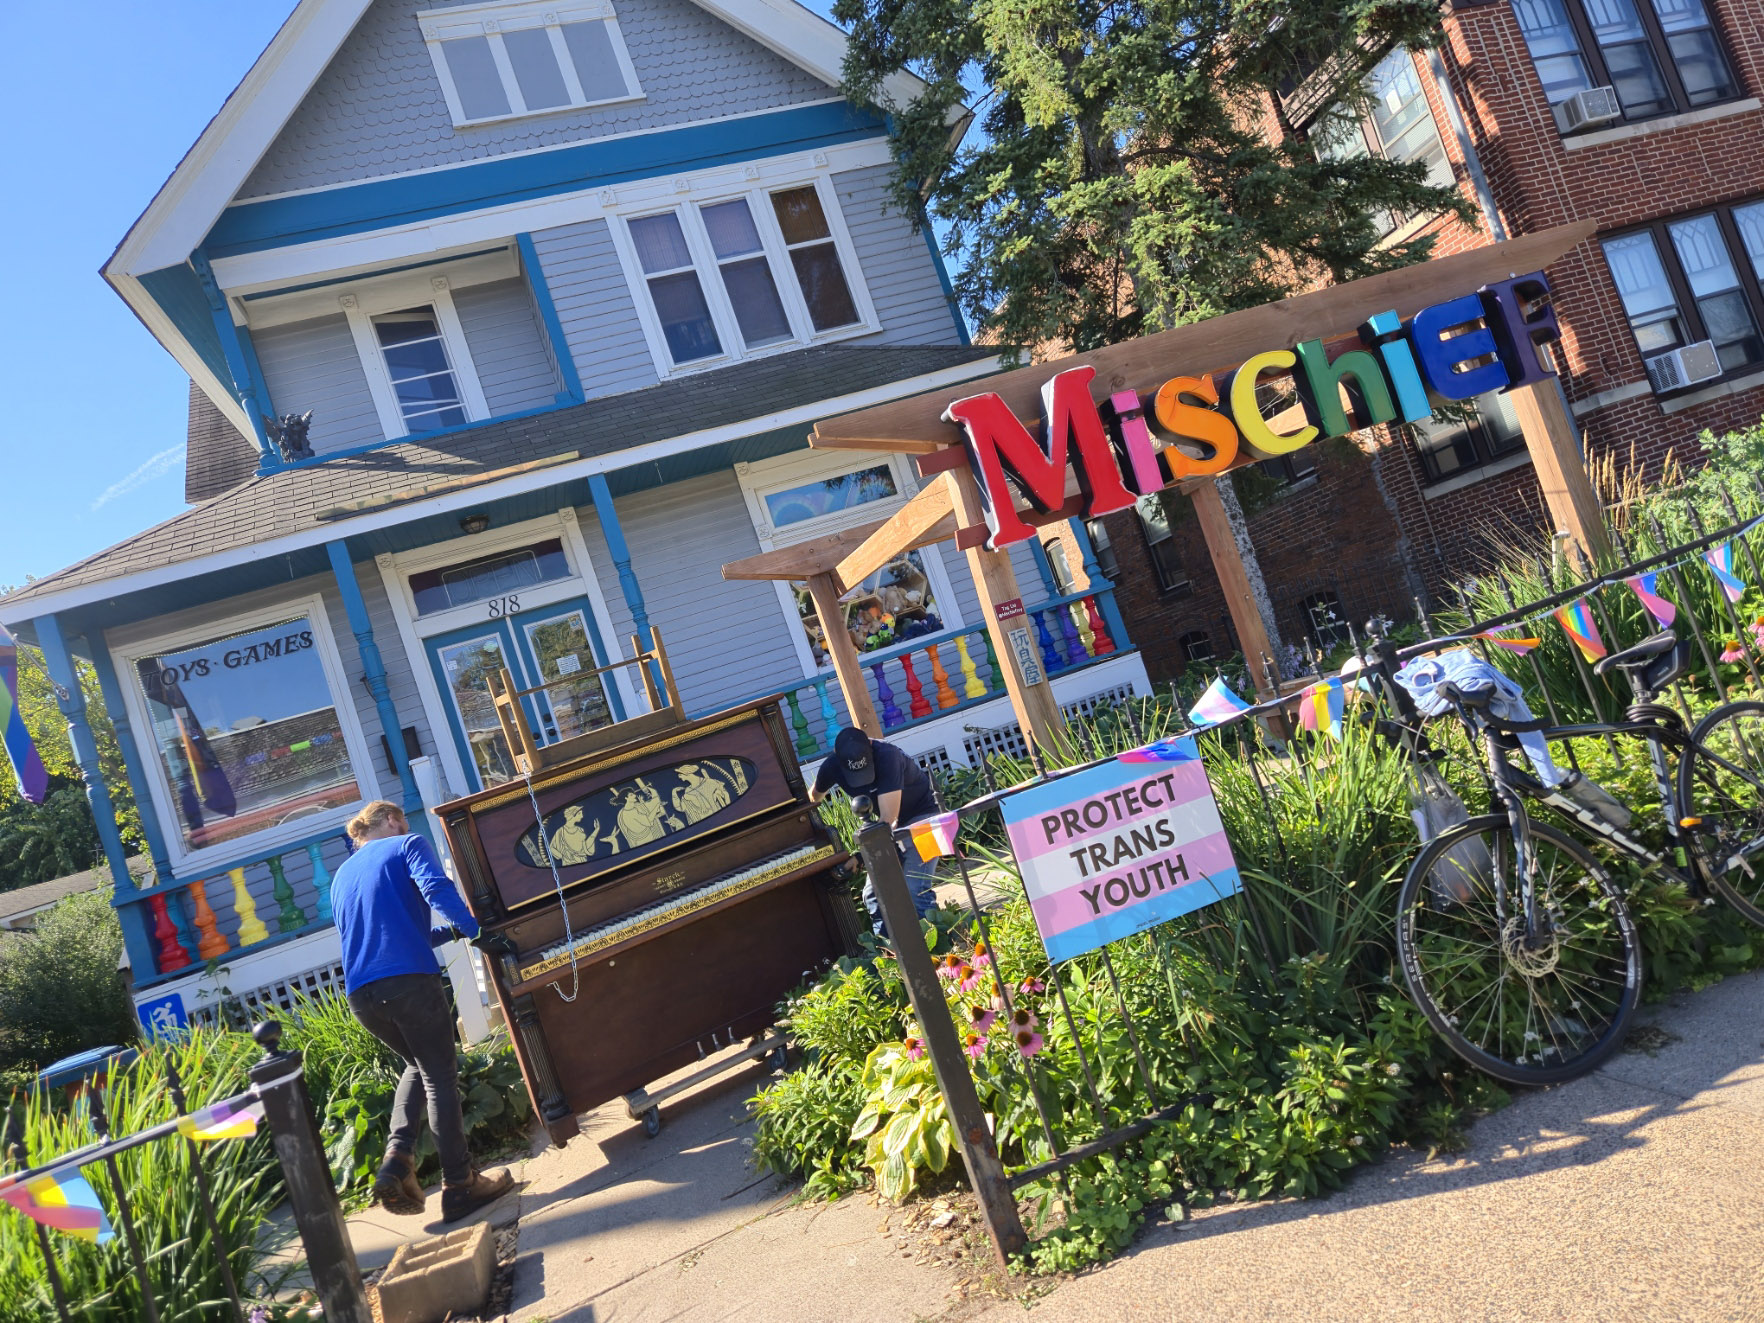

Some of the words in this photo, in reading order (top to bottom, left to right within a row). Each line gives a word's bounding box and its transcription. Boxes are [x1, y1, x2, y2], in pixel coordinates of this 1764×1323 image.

[447, 556, 540, 601] OPEN
[488, 594, 521, 618] 818
[142, 658, 211, 691] TOYS
[223, 631, 314, 670] GAMES
[1010, 629, 1041, 685] 玩具屋
[1041, 773, 1177, 845] PROTECT
[1070, 819, 1175, 877] TRANS
[1079, 854, 1190, 915] YOUTH
